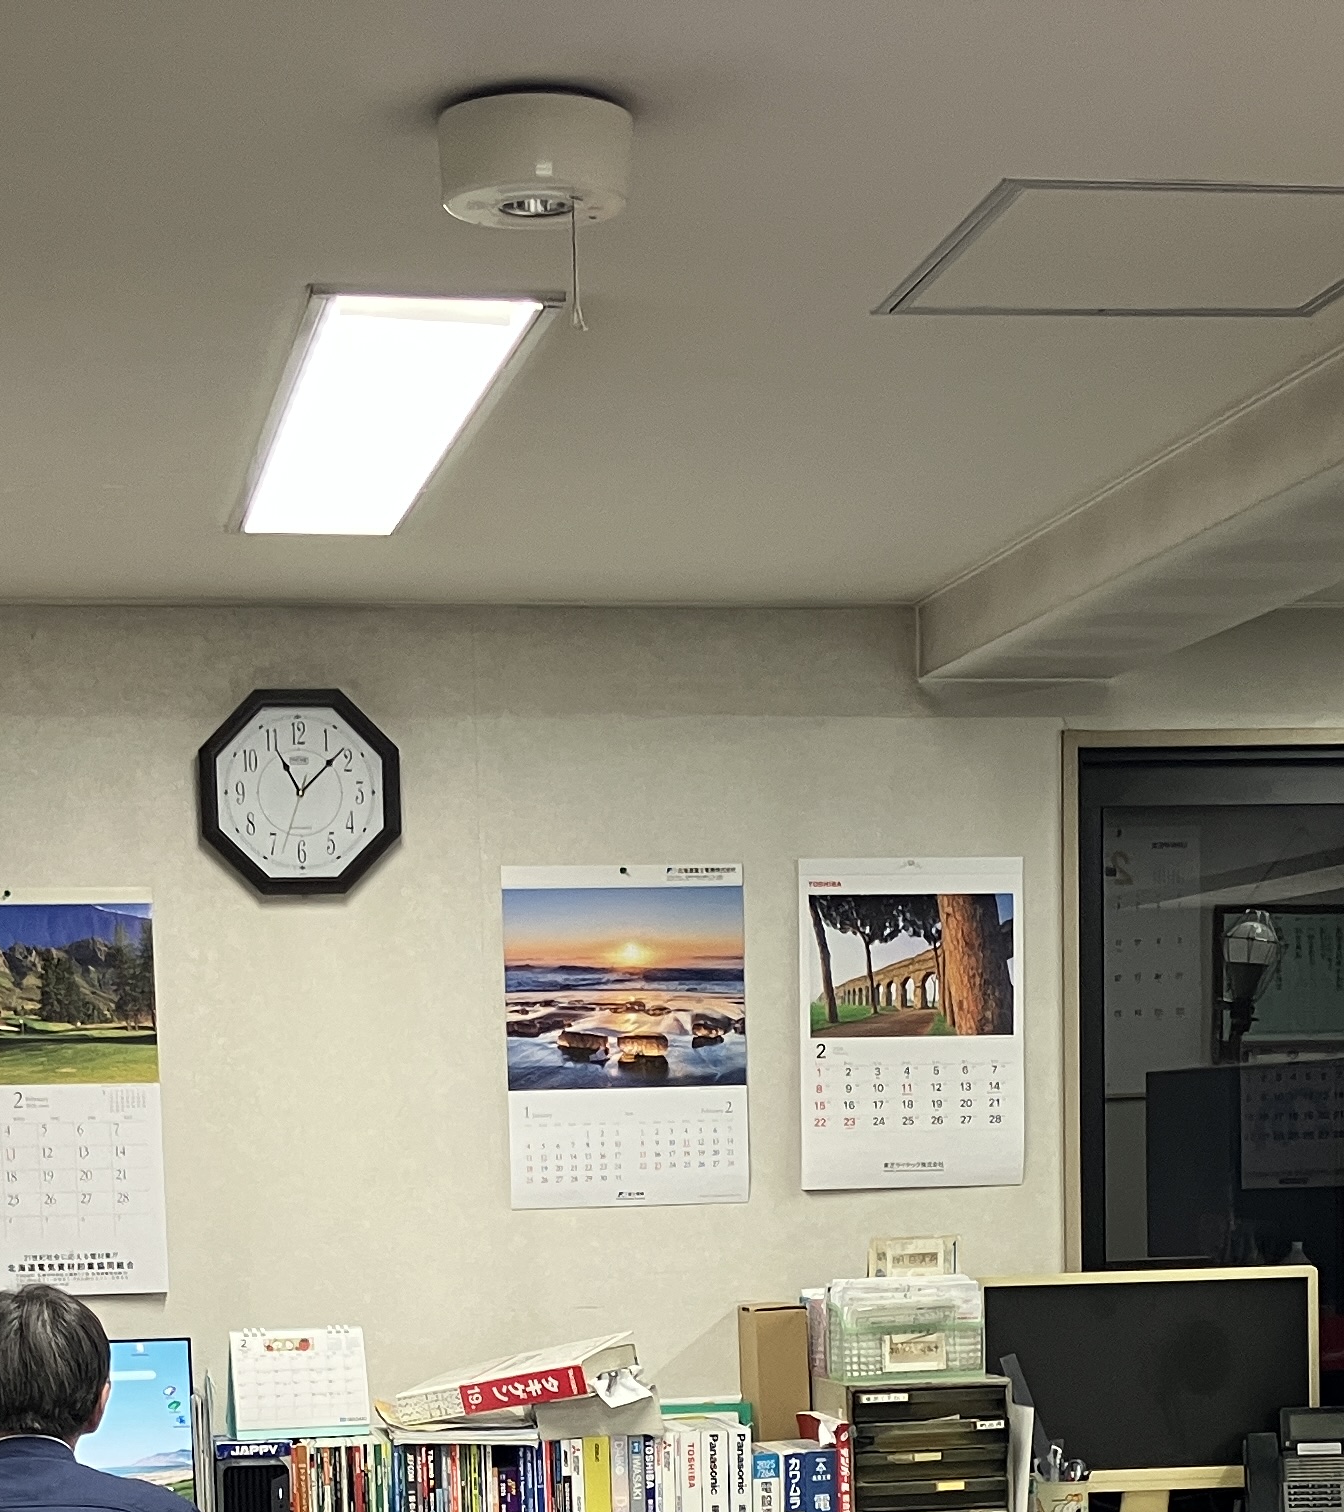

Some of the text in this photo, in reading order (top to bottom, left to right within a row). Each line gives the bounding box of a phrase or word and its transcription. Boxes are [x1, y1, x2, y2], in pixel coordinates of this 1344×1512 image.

[266, 729, 278, 752] 11
[291, 721, 306, 745] 12
[324, 728, 328, 751] 1
[243, 749, 257, 772] 10
[344, 749, 352, 772] 2
[235, 781, 245, 805] 9
[355, 781, 364, 805] 3
[246, 812, 255, 836] 8
[346, 811, 354, 834] 4
[270, 832, 277, 855] 7
[298, 839, 306, 864] 6
[327, 832, 335, 855] 5
[816, 1043, 827, 1059] 2
[13, 1091, 23, 1109] 2
[492, 1375, 560, 1402] タキゲン
[645, 1440, 655, 1489] TOSHIBA
[687, 1443, 696, 1489] TOSHIBA
[709, 1433, 719, 1495] Panasonic
[736, 1433, 747, 1495] Panasonic
[632, 1456, 642, 1500] IWASAKI
[788, 1457, 801, 1510] カワムラ
